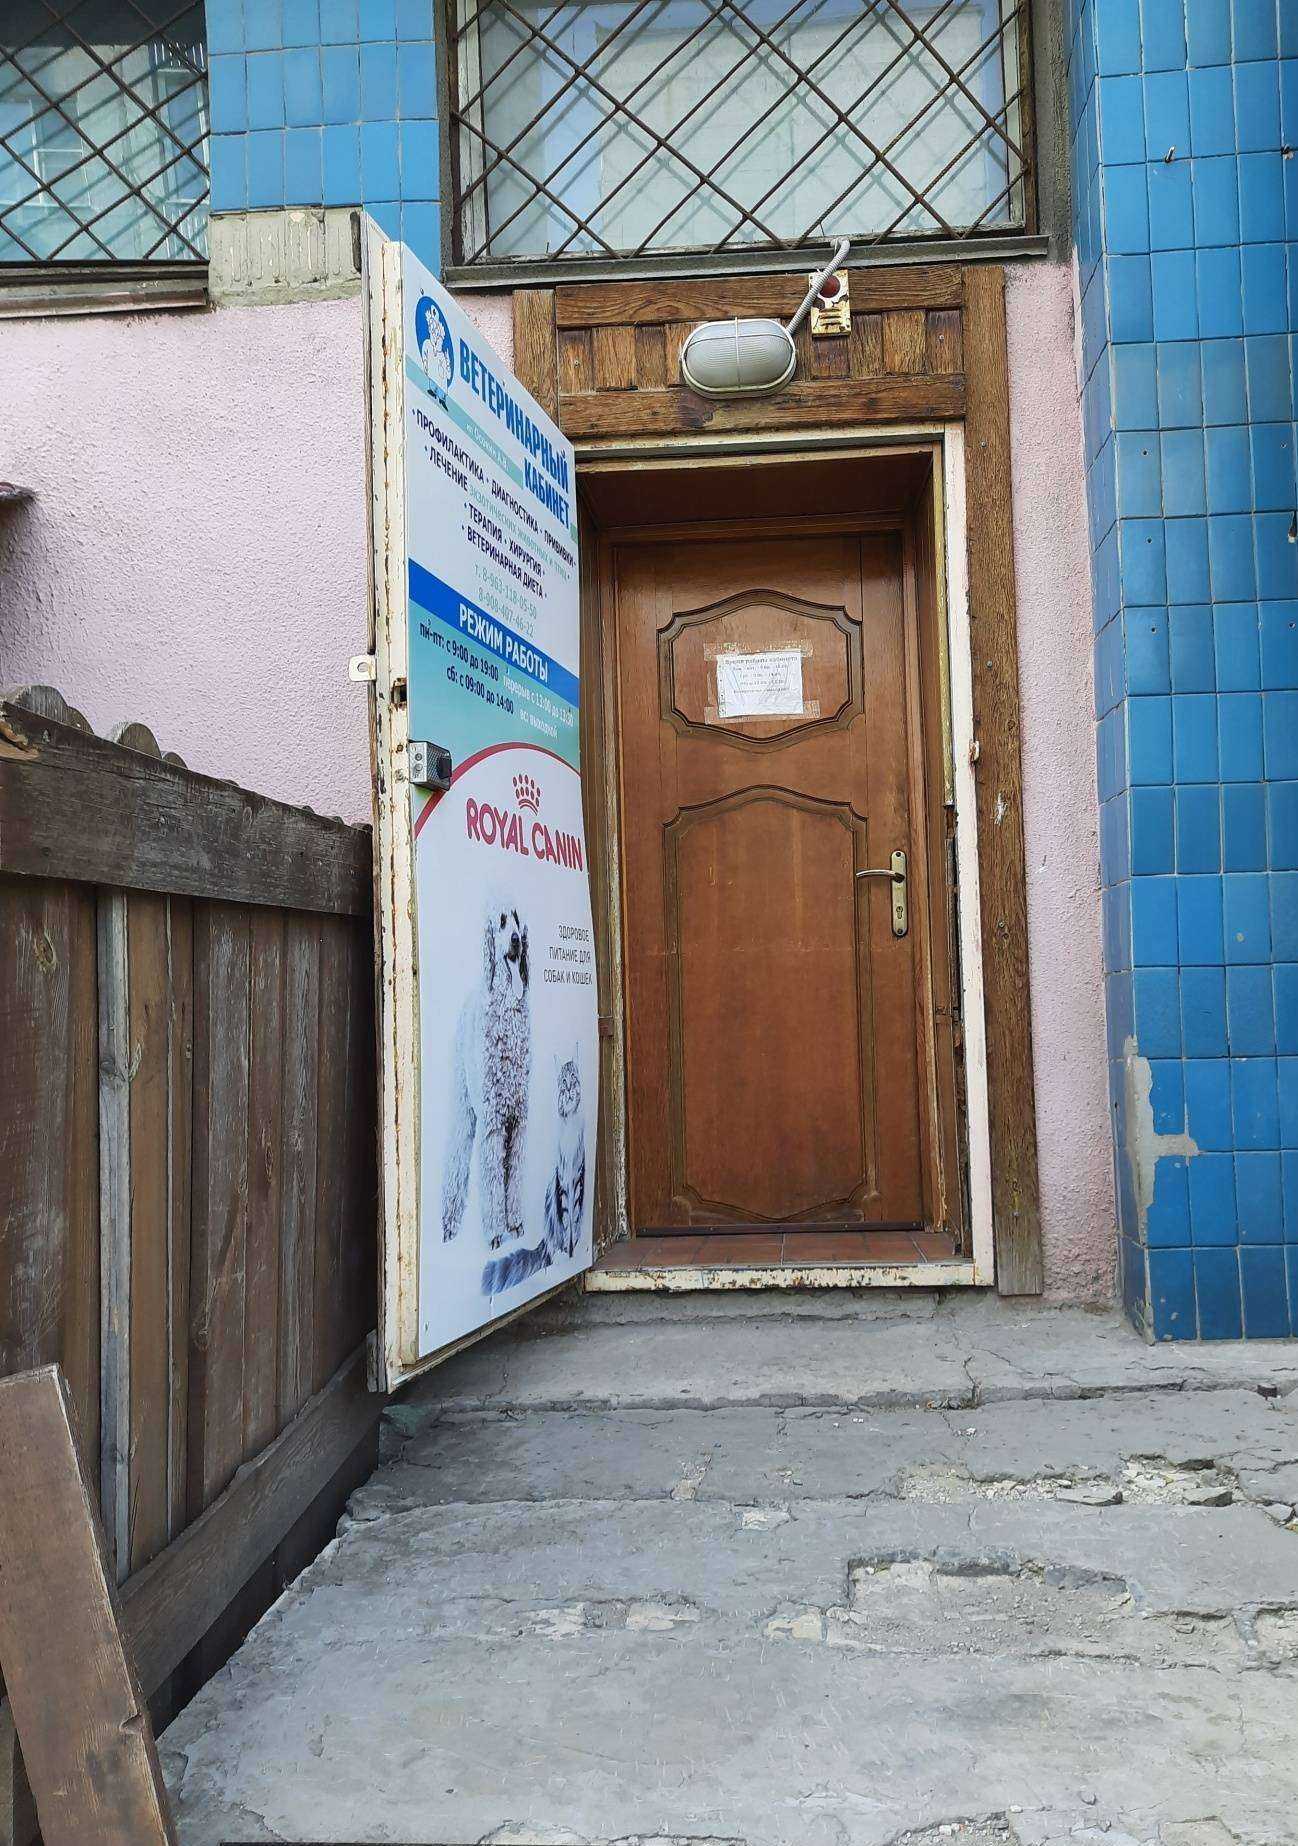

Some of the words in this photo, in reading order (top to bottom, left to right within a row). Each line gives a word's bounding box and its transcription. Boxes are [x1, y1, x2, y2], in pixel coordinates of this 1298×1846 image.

[459, 337, 569, 494] ВЕТЕРИНАРНЫЙ
[417, 408, 484, 485] ПРОФИЛАКТИКА
[491, 478, 538, 536] ДИАГНОСТИКА
[544, 529, 574, 568] ПРИВИВКИ
[429, 444, 468, 493] ЛЕЧЕНИЕ
[524, 457, 570, 530] КАБИНЕТ
[467, 525, 522, 583] ВЕТЕРИНАРНАЯ
[522, 570, 543, 602] ДИЕТА
[469, 502, 502, 545] ТЕРАПИЯ
[508, 537, 541, 578] ХИРУРГИЯ
[452, 640, 468, 664] 9:00
[469, 655, 479, 672] до
[480, 657, 498, 682] 19:00
[459, 602, 503, 654] РЕЖИМ
[505, 634, 548, 684] РАБОТЫ
[446, 663, 458, 684] сб:
[465, 674, 485, 699] 09:00
[486, 689, 495, 707] до
[496, 691, 514, 715] 14:00
[466, 798, 529, 856] ROYAL
[532, 822, 583, 871] CANIN
[549, 946, 578, 962] ПИТАНИЕ
[579, 950, 591, 964] ДЛЯ
[558, 925, 590, 942] ЗДОРОВОЕ
[544, 969, 564, 984] СОБАК
[572, 971, 592, 985] КОШЕК
